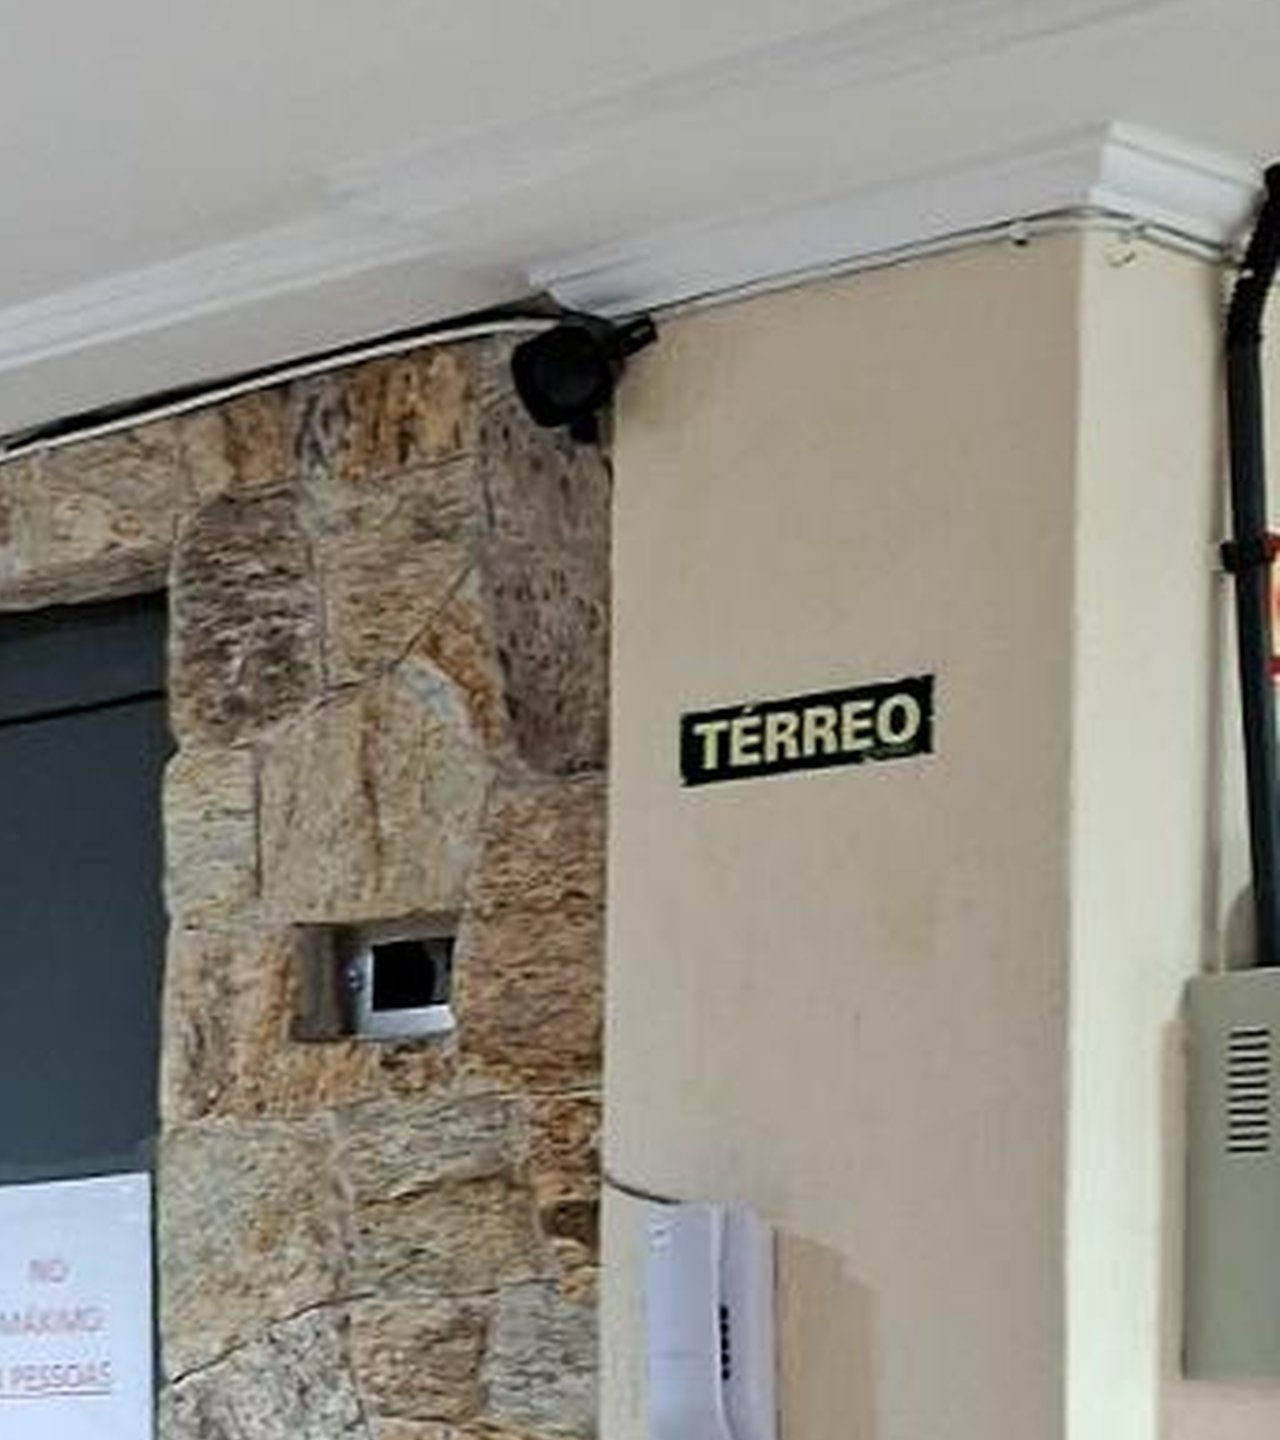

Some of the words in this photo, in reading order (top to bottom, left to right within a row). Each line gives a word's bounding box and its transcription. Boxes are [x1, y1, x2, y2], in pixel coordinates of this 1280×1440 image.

[692, 691, 922, 771] TÉRREO
[26, 1258, 71, 1284] NO
[9, 1360, 113, 1391] PESSOAS
